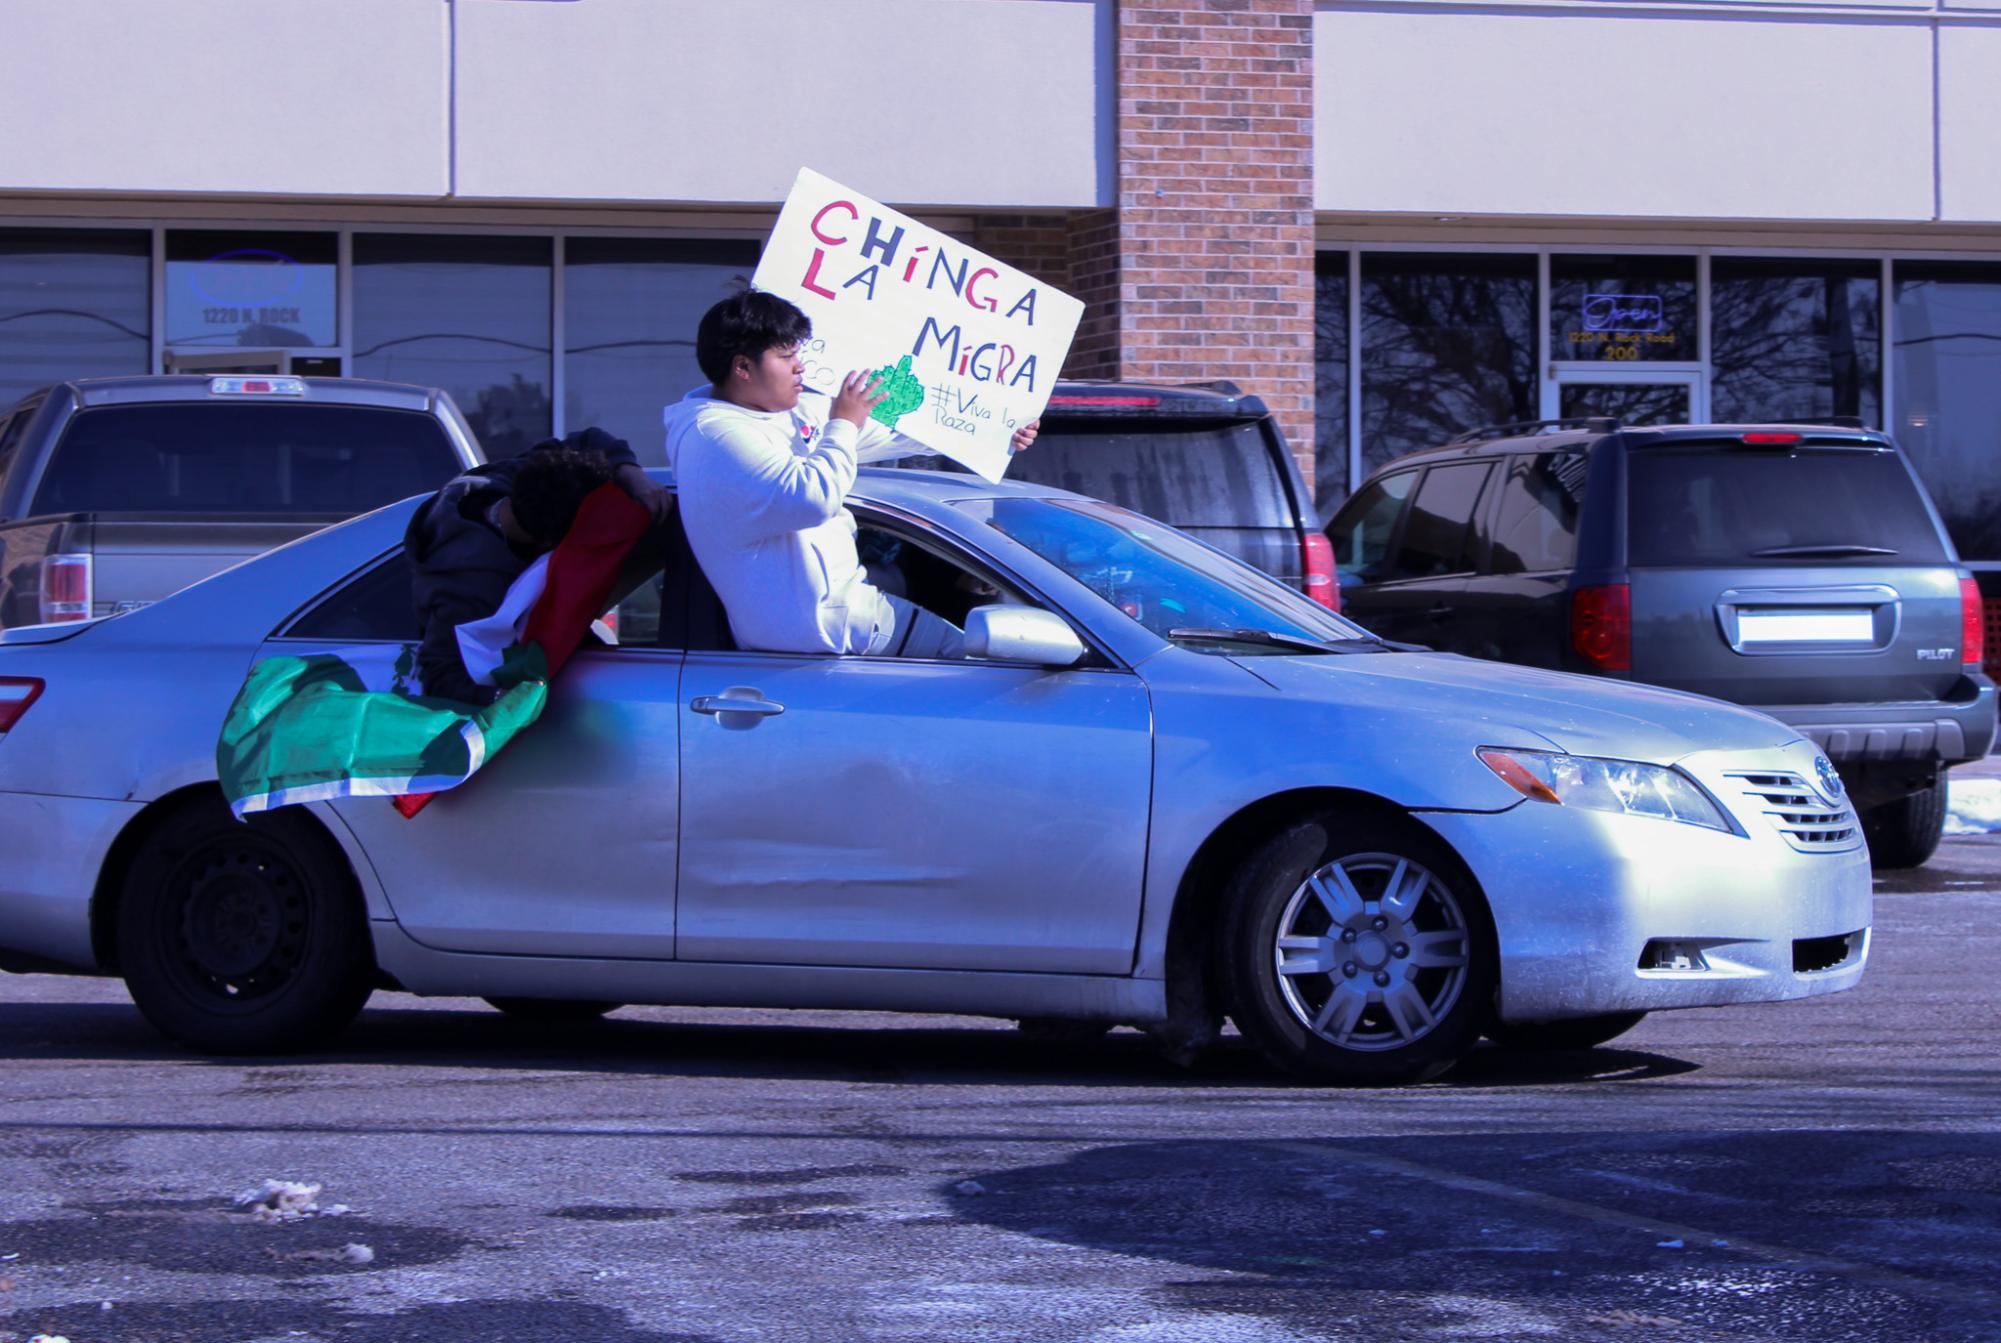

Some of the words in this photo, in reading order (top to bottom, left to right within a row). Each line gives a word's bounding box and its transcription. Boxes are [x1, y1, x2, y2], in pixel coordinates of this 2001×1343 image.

[801, 247, 880, 301] LA
[203, 308, 238, 323] 1220
[259, 308, 300, 323] ROCK
[1584, 297, 1661, 329] Open
[1605, 346, 1638, 361] 200
[931, 383, 991, 419] #Viva
[1002, 407, 1016, 429] la
[931, 404, 976, 435] Raza
[1917, 648, 1955, 660] PILOT
